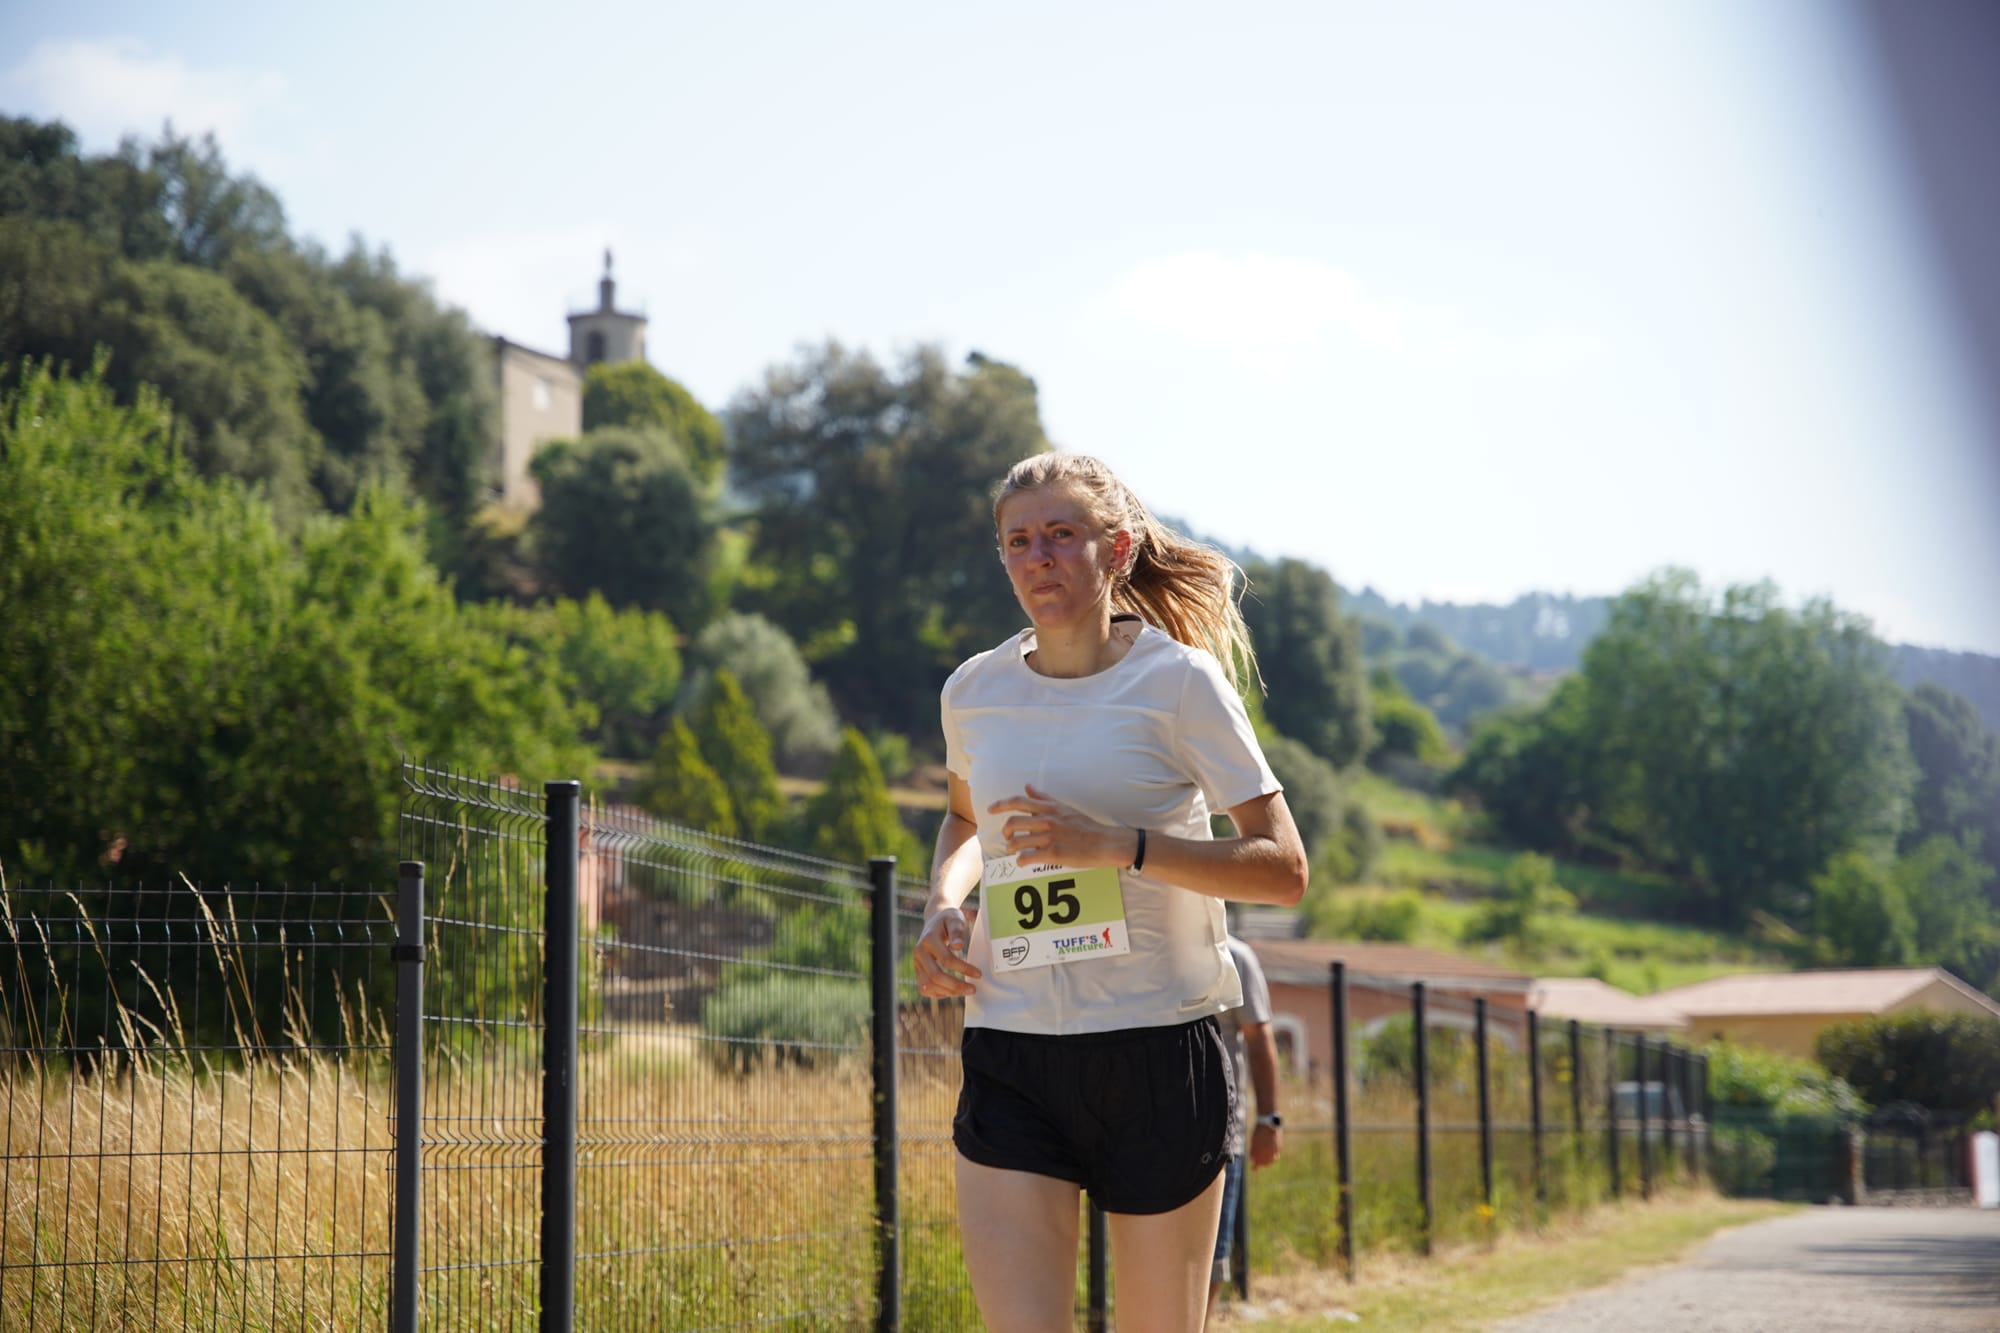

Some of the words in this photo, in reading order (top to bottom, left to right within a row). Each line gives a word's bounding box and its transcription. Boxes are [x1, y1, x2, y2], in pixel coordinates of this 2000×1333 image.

[1014, 878, 1080, 930] 95
[1052, 934, 1098, 949] TUFF'S
[1058, 942, 1104, 955] Aventure
[1002, 946, 1026, 958] BFP
